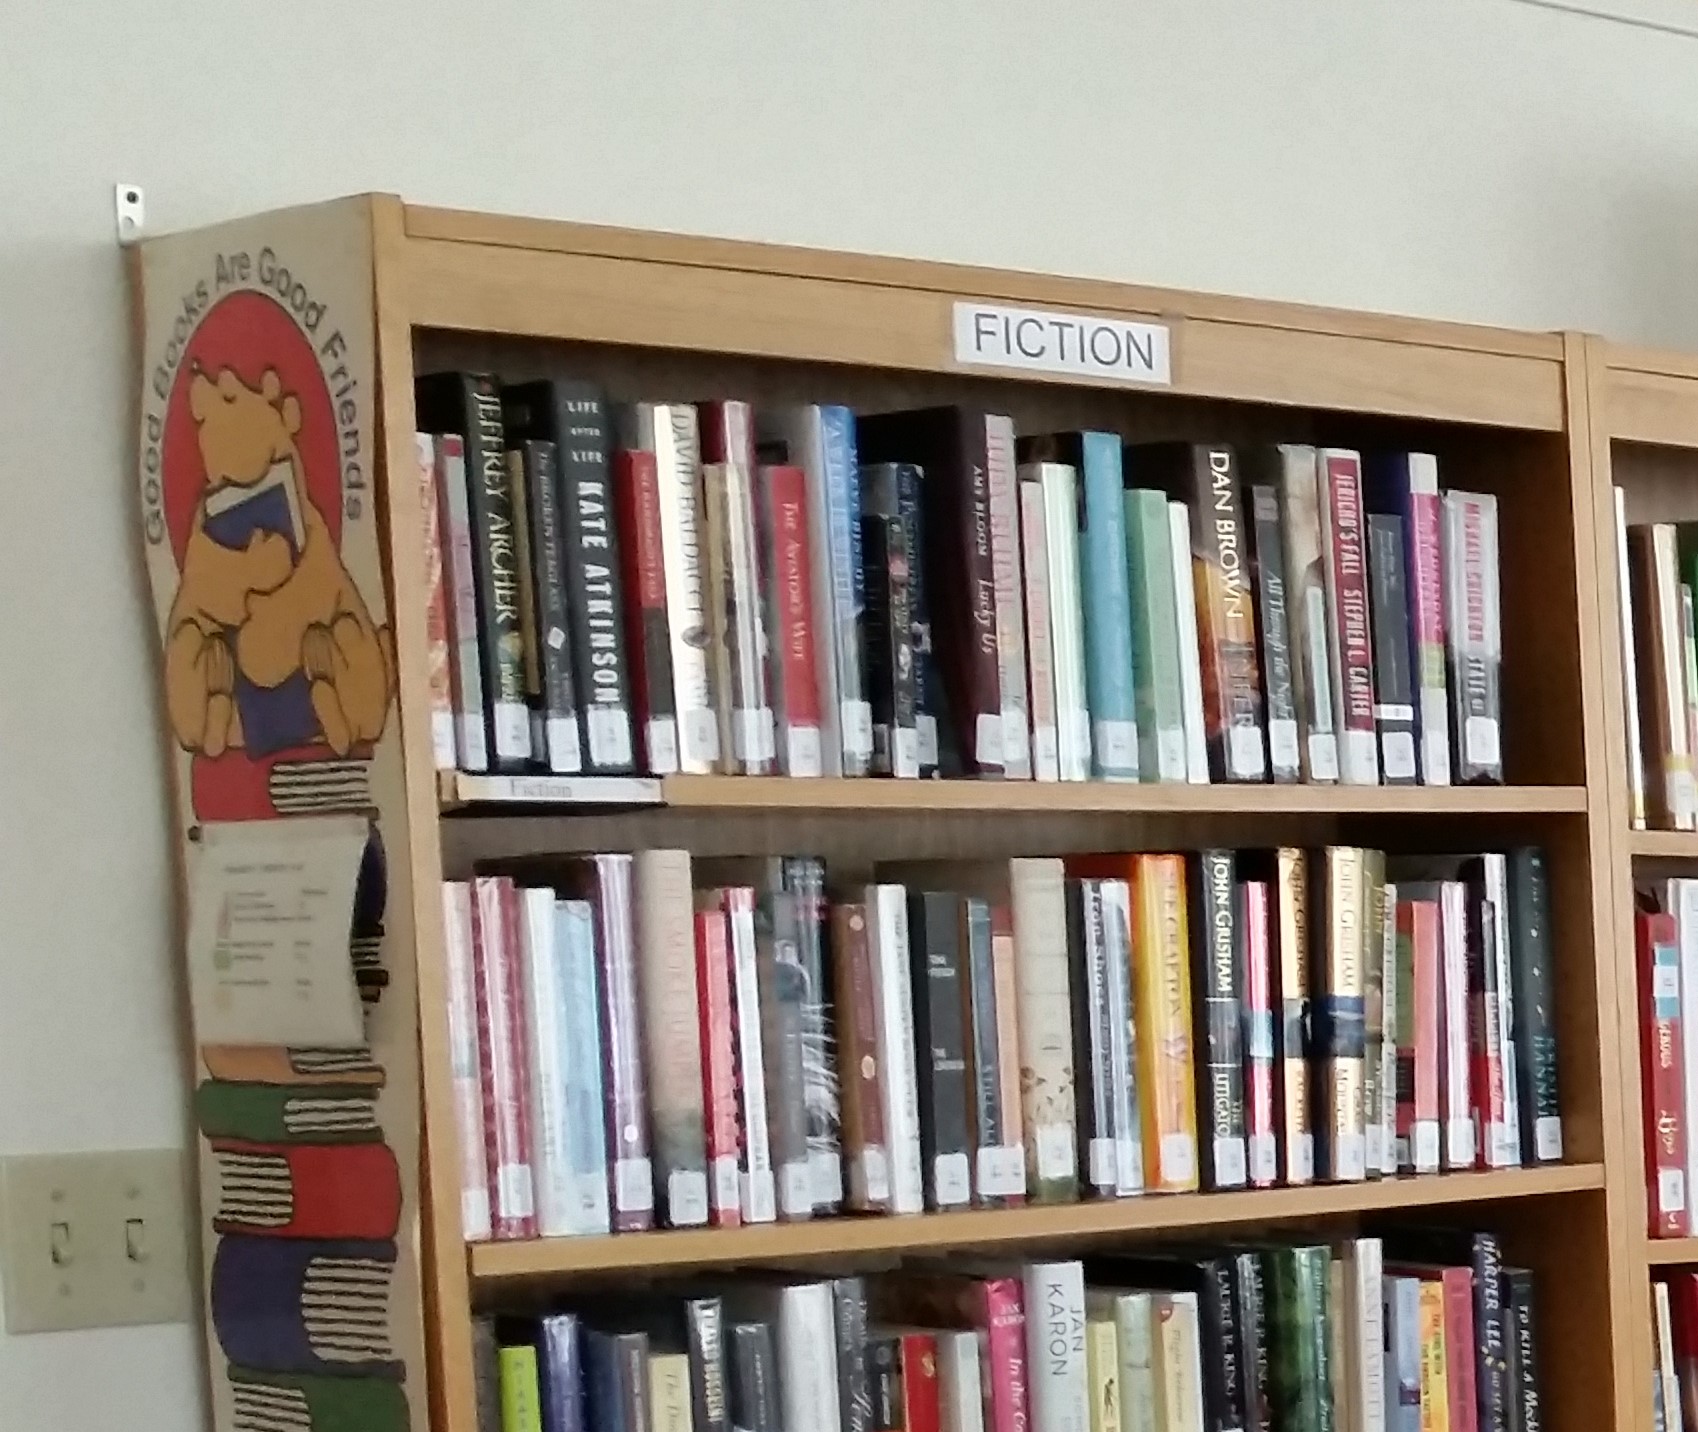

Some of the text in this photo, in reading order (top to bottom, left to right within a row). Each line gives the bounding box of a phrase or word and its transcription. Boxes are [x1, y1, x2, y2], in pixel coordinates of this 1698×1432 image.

[974, 312, 1155, 372] FICTION
[144, 246, 362, 547] Good Books Are Good Friends
[471, 392, 519, 624] JEFFREY ARCHER
[671, 413, 705, 614] DAVID BALDACCI
[1209, 452, 1242, 619] DAN BROWN
[1333, 474, 1360, 541] JERICHO'S
[781, 502, 800, 531] THE
[791, 622, 807, 661] WIFE
[973, 465, 997, 654] AMY BLOOM Lucky Us
[1266, 571, 1283, 596] All
[1341, 545, 1360, 575] FALL
[576, 481, 621, 704] KATE ATKINSON
[1343, 589, 1366, 647] STEPHEN
[1266, 599, 1288, 653] Through
[1222, 647, 1252, 726] INFER
[1273, 657, 1287, 676] the
[1348, 667, 1371, 716] CARTER
[510, 779, 573, 799] Fiction
[1337, 857, 1355, 904] JOHN
[1210, 856, 1234, 992] JOHN GRISHAM
[980, 1064, 996, 1108] STILL
[1213, 1073, 1232, 1137] LITIGATO
[1482, 1240, 1502, 1348] HARPER LEE
[1519, 1304, 1530, 1324] TO
[1046, 1283, 1068, 1377] KARON
[1070, 1304, 1086, 1353] JAN
[1521, 1330, 1533, 1367] KILL
[1008, 1357, 1023, 1377] In
[1009, 1381, 1025, 1408] the
[1523, 1371, 1532, 1383] A
